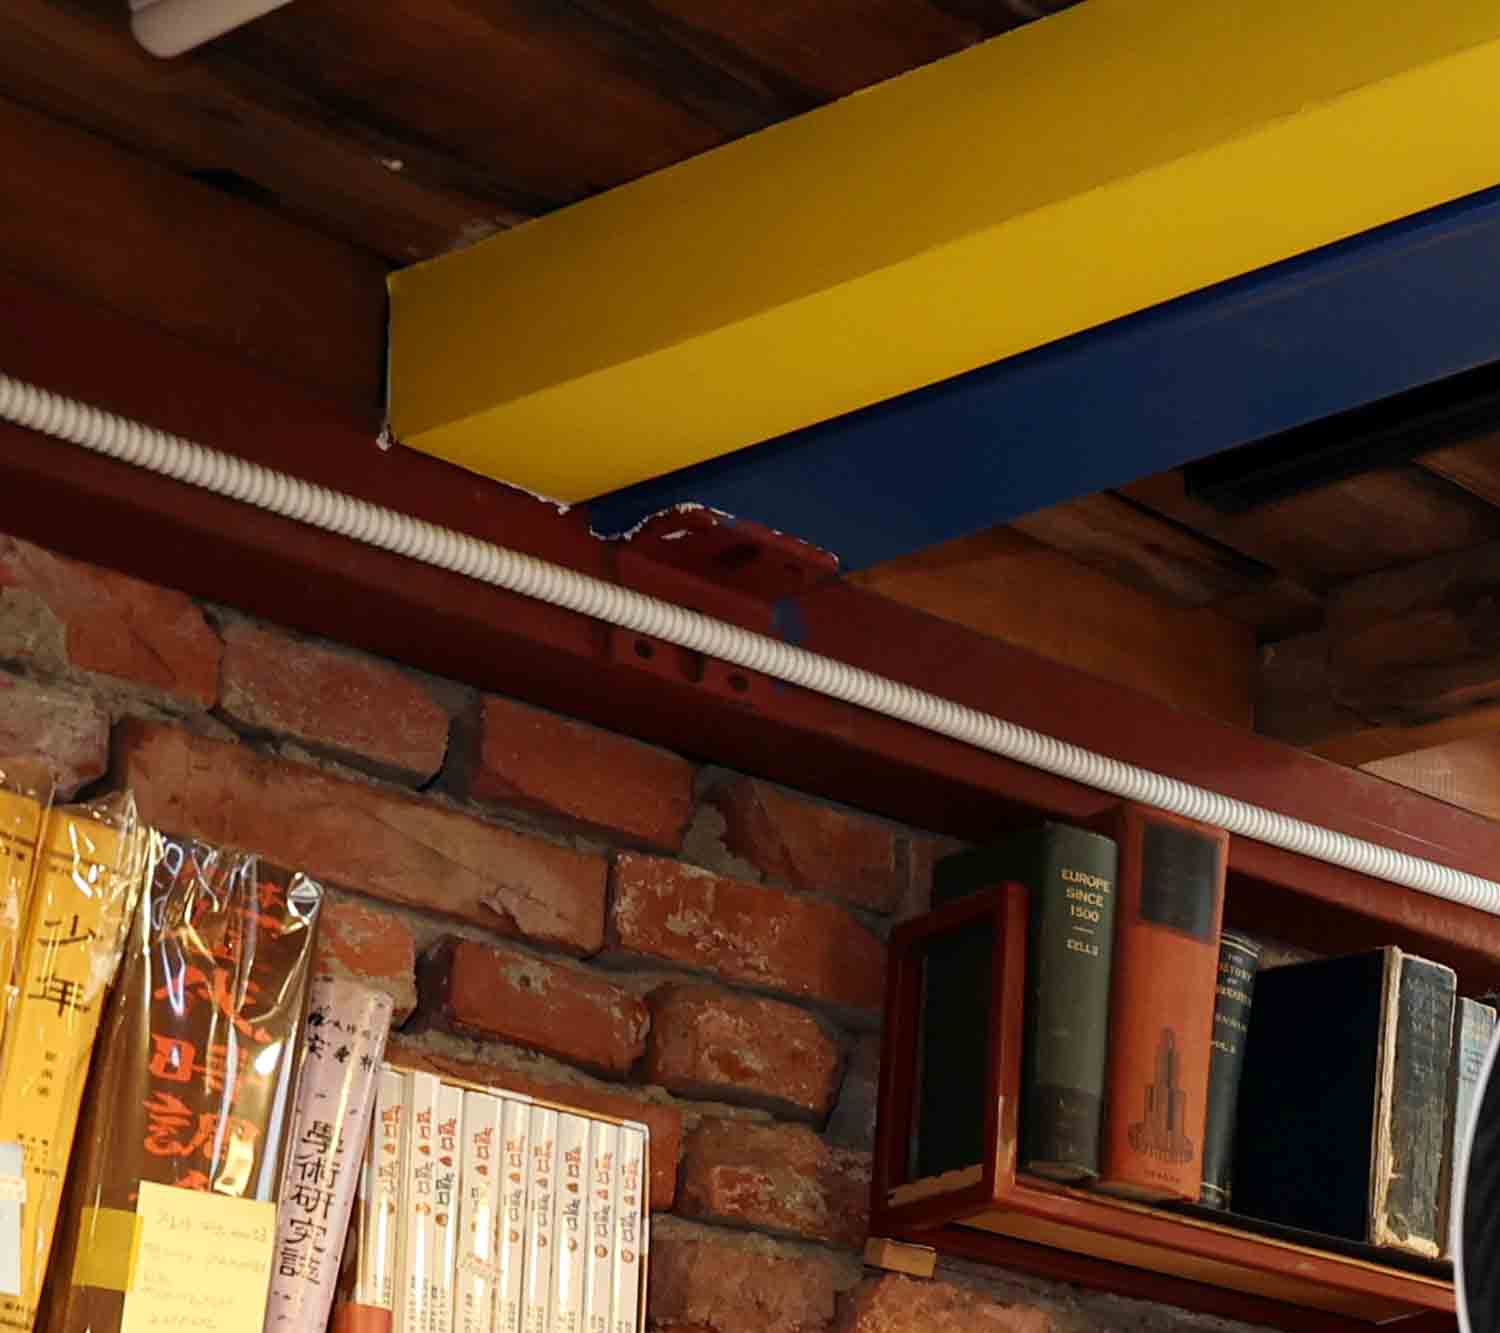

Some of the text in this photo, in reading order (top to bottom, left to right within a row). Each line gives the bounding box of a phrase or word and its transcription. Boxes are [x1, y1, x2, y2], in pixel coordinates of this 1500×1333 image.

[1060, 867, 1113, 893] EUROPE
[1065, 886, 1106, 907] SINCE
[1068, 903, 1101, 924] 1500
